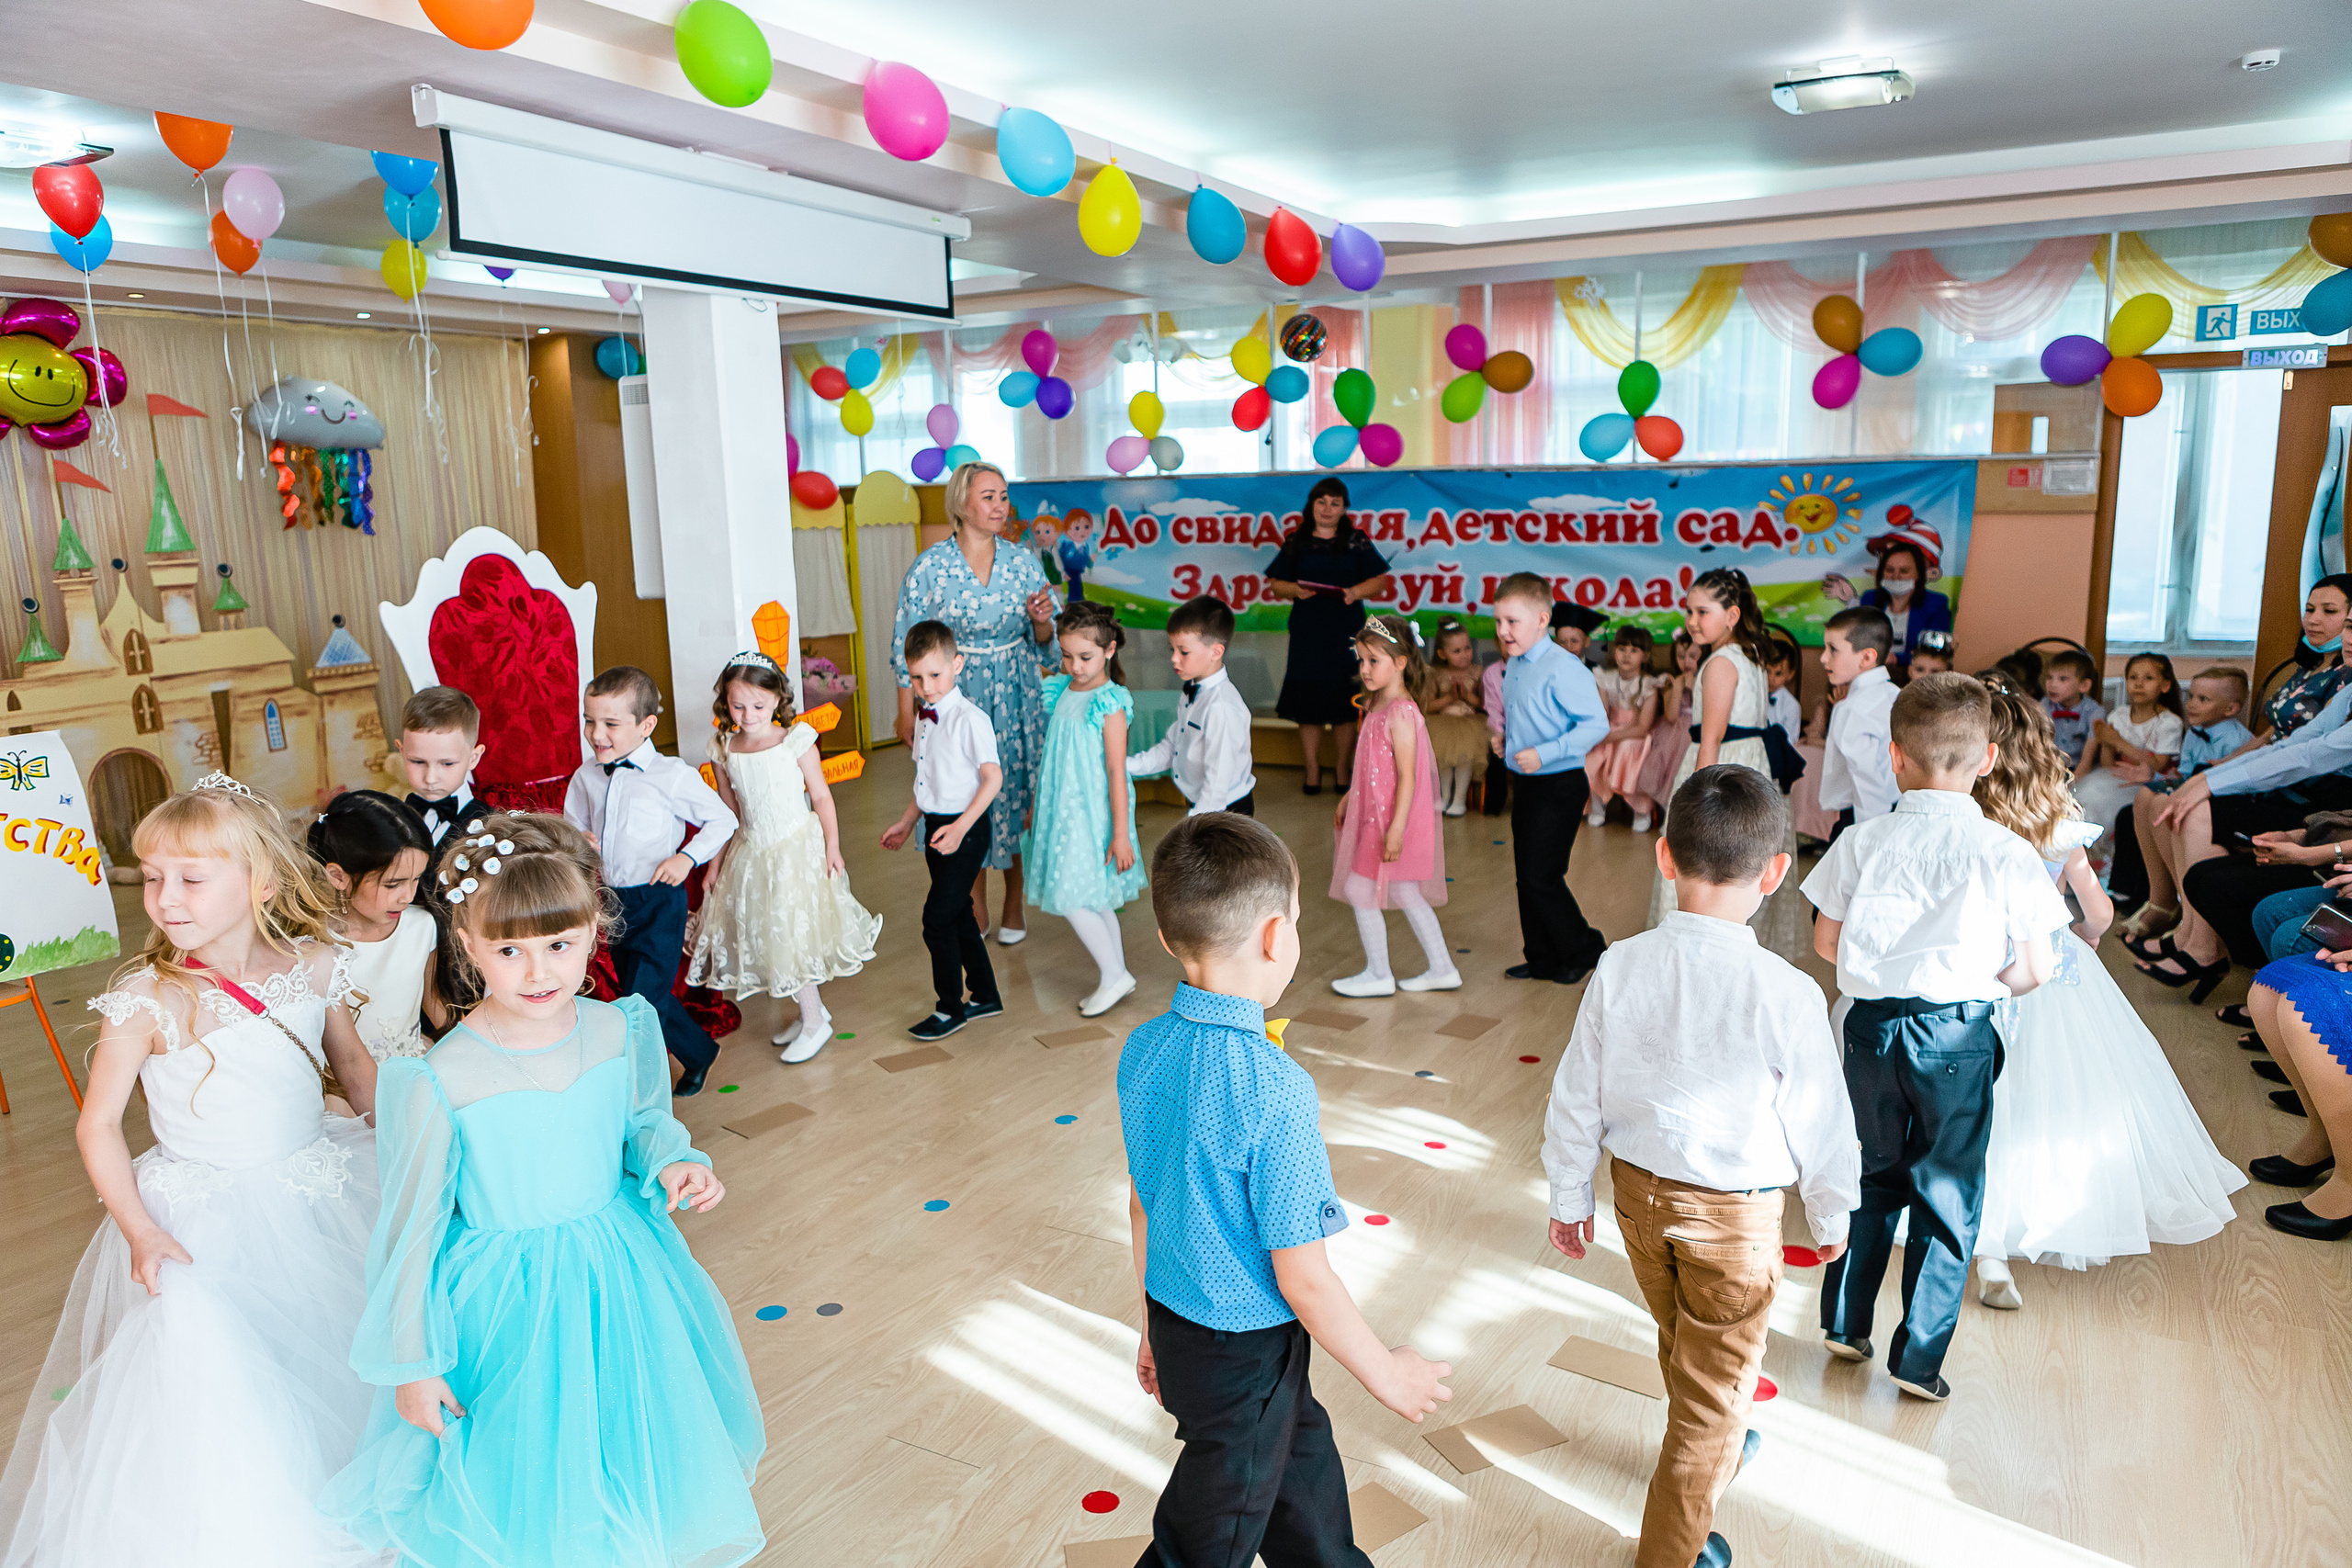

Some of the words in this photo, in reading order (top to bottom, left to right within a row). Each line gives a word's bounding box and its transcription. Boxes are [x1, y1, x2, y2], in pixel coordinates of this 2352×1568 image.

[2256, 310, 2301, 330] ВЫХ
[2250, 349, 2319, 367] ВЫХОД
[1099, 506, 1159, 550] До
[1170, 511, 1417, 553] свидия,
[1419, 501, 1659, 547] детский
[1678, 511, 1799, 550] сад.
[1170, 562, 1477, 617] Здрвуй,
[1480, 565, 1694, 609] ола!
